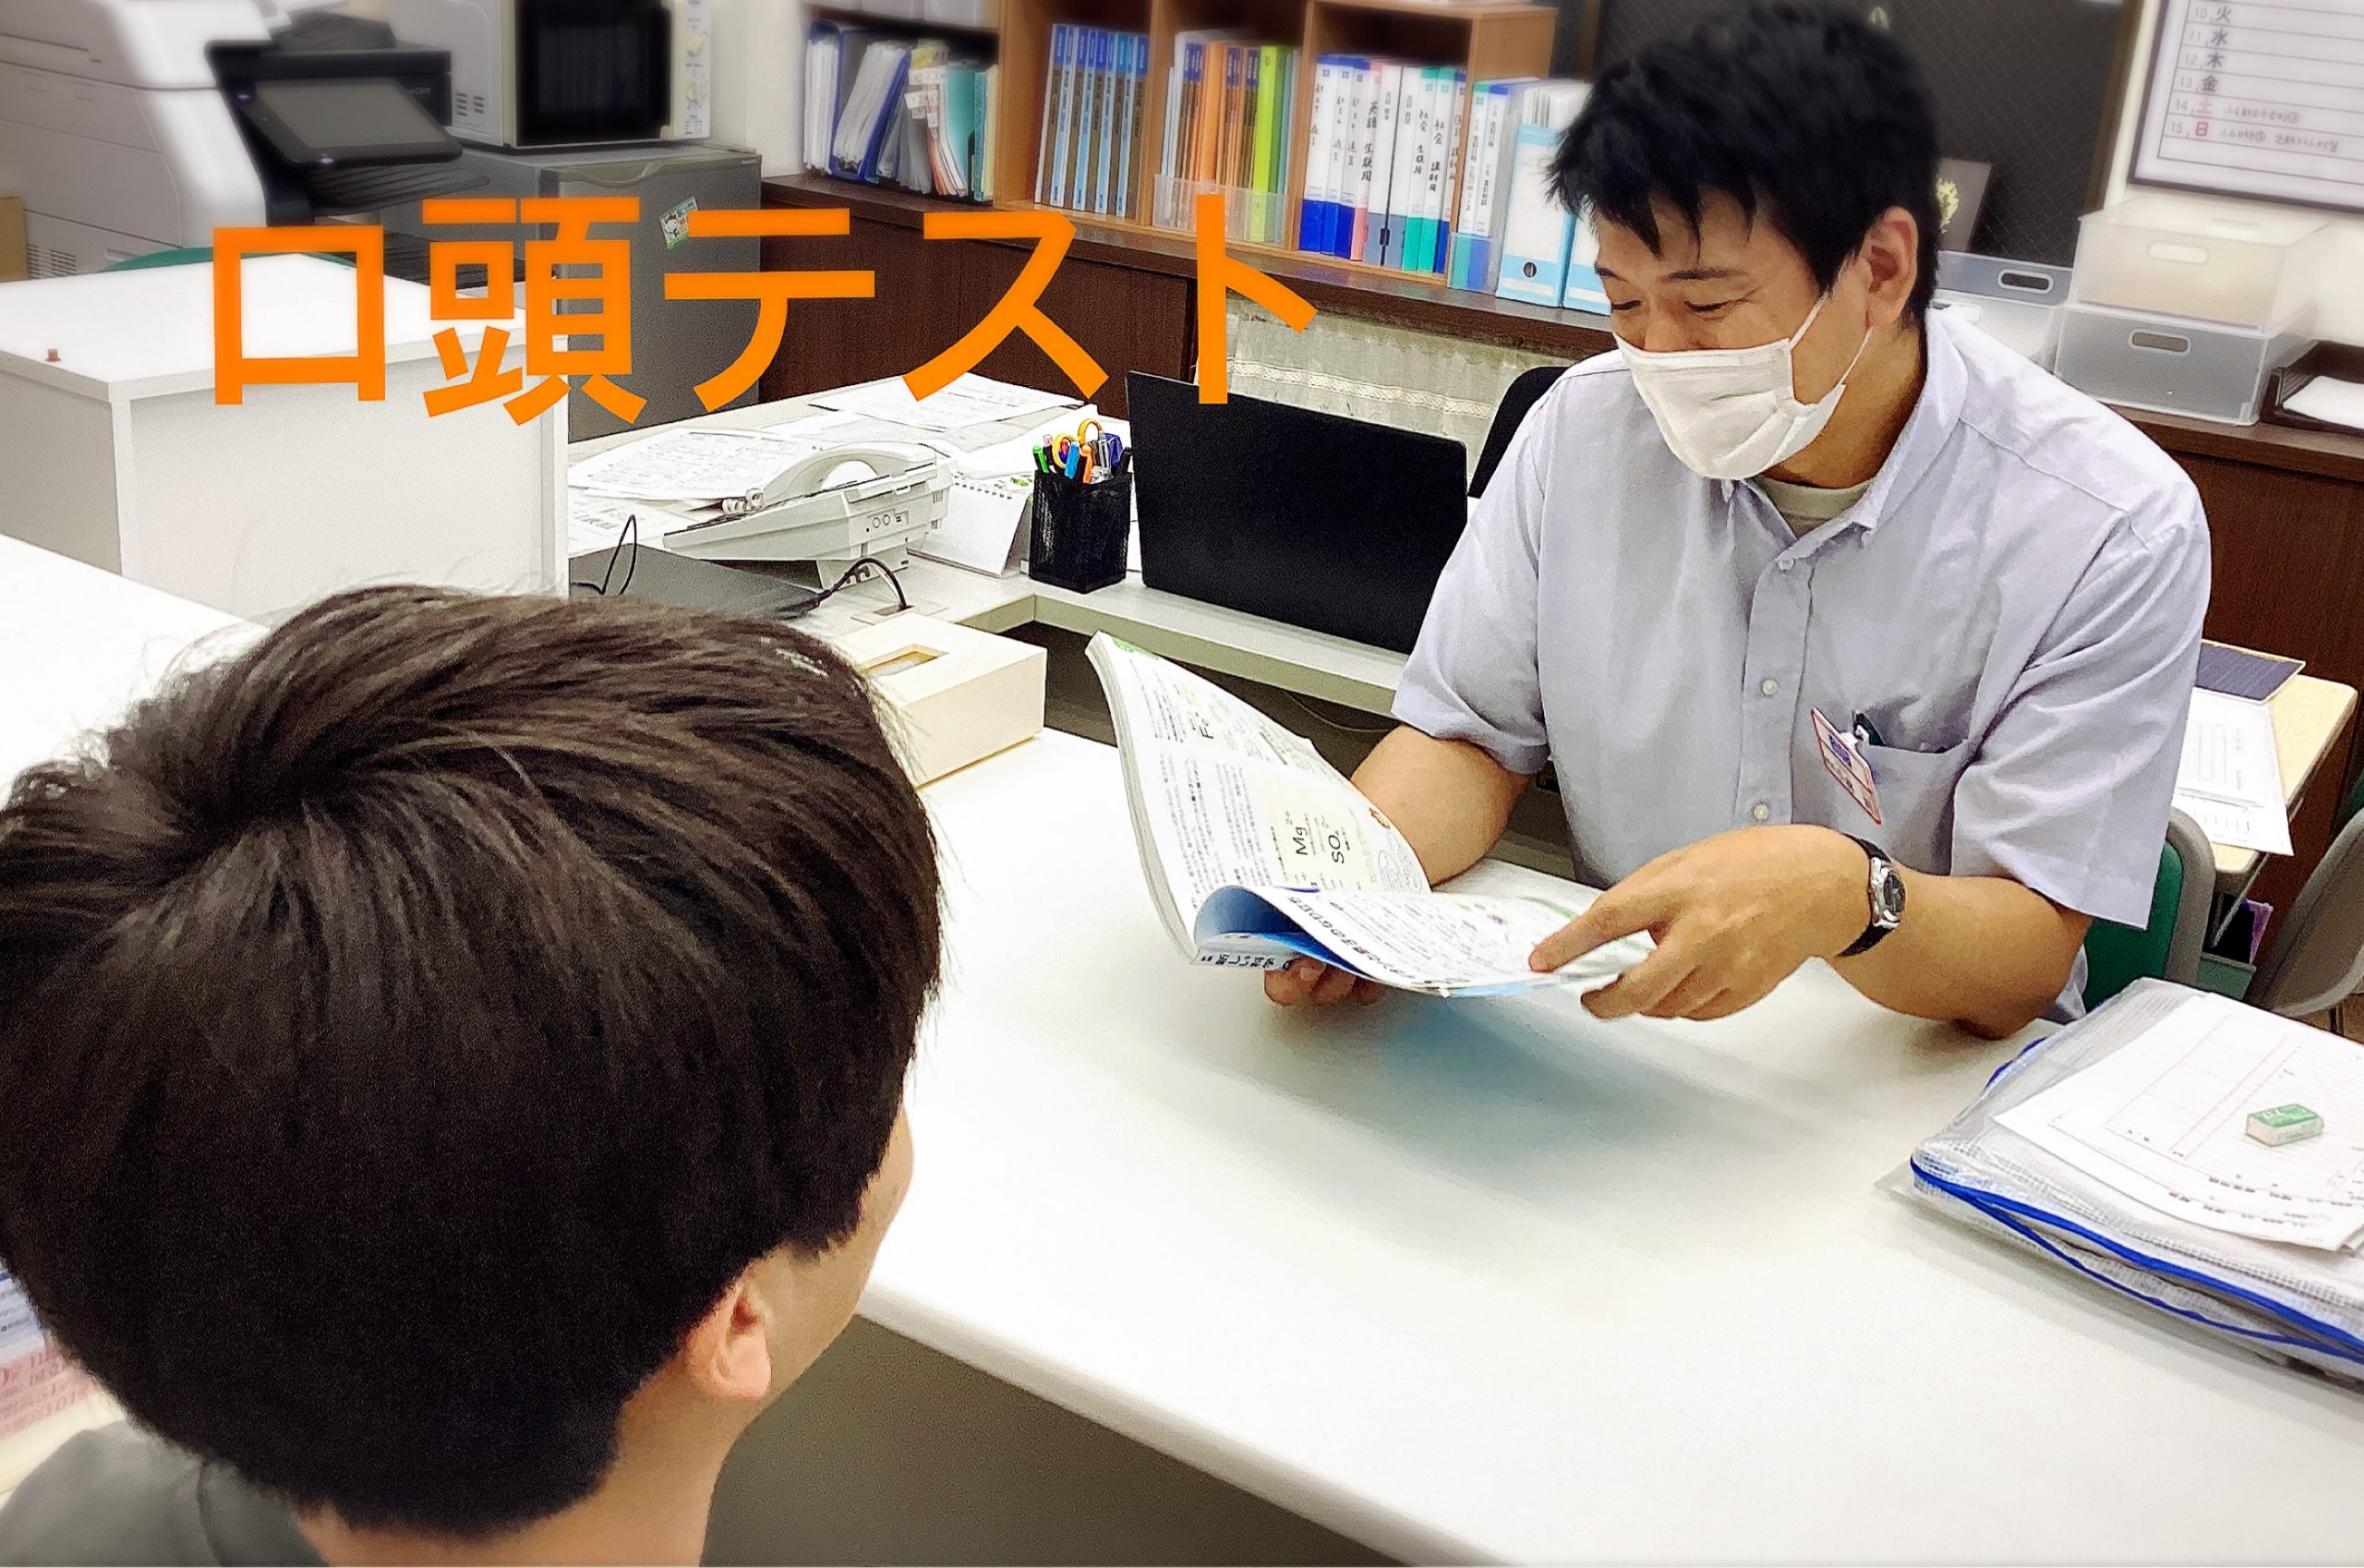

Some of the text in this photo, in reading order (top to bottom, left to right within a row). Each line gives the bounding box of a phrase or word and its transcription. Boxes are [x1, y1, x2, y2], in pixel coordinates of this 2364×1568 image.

[2215, 6, 2232, 22] 火
[2211, 30, 2228, 45] 水
[2185, 53, 2224, 68] 12 木
[2180, 75, 2219, 93] 13 金
[2176, 98, 2212, 115] 14 土
[1434, 117, 1444, 145] 社会
[2171, 121, 2209, 137] 15 日
